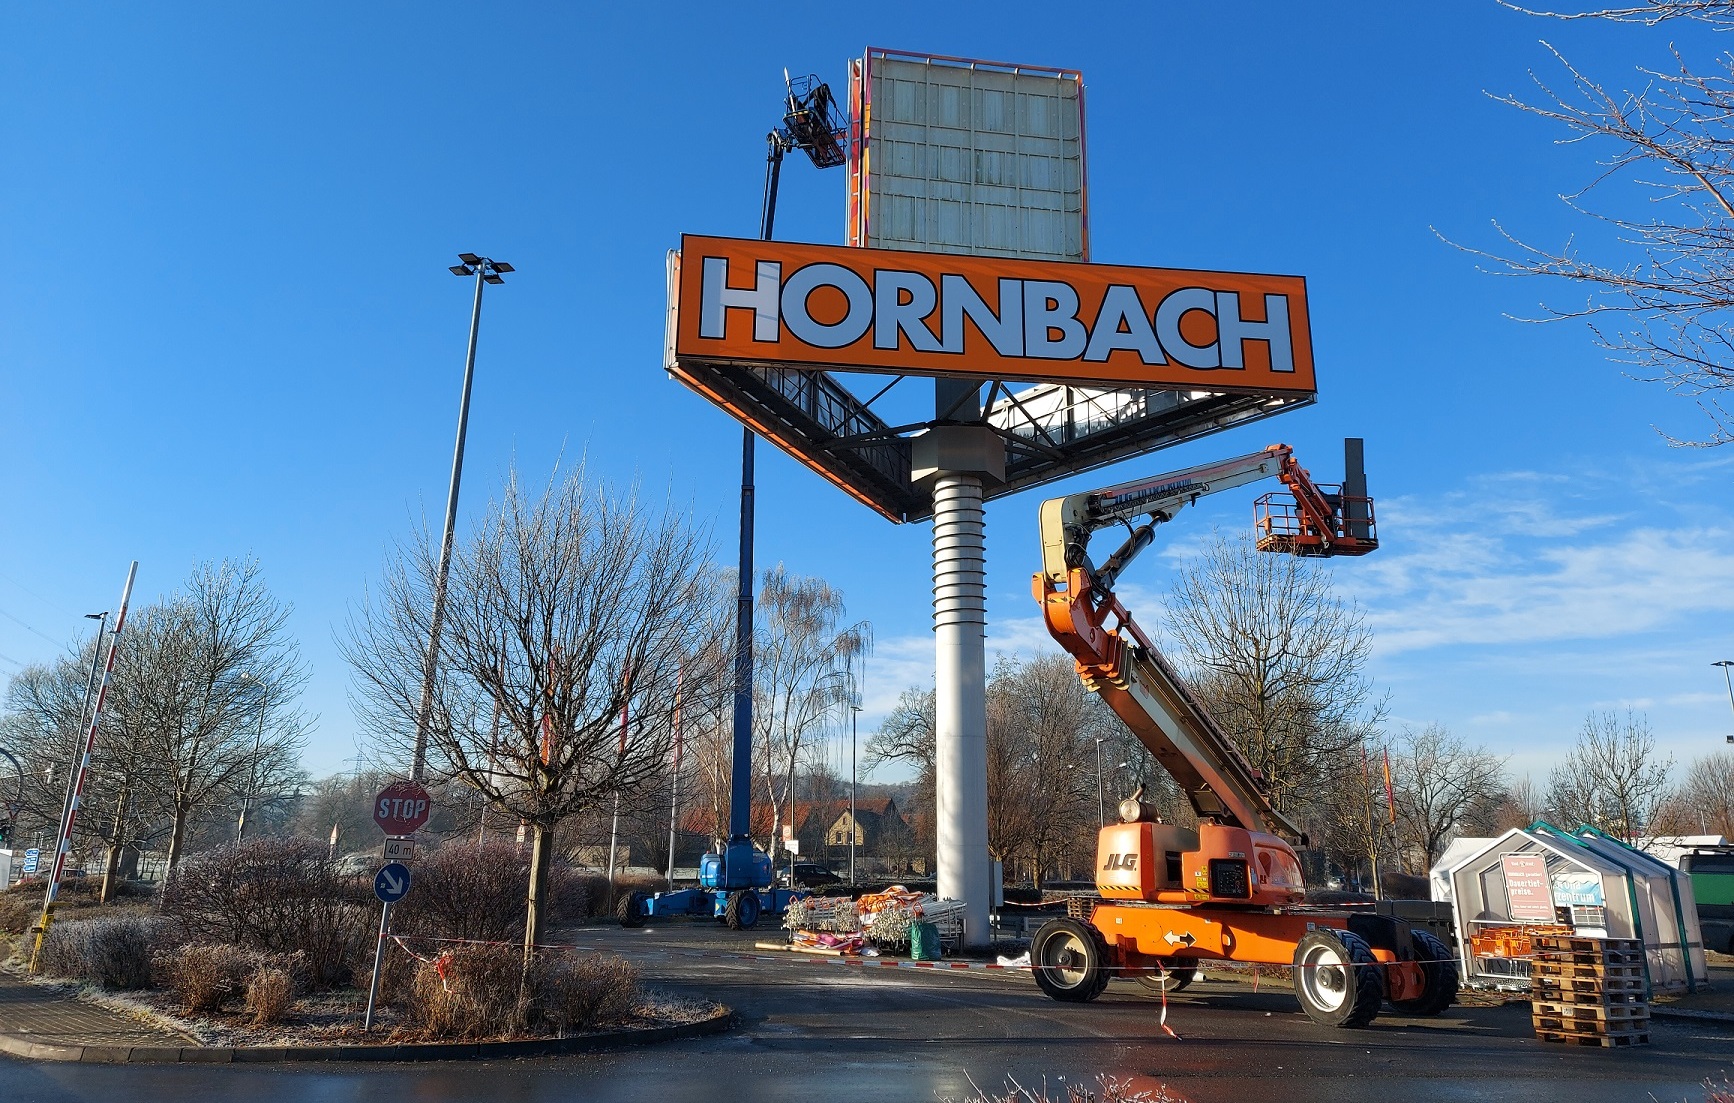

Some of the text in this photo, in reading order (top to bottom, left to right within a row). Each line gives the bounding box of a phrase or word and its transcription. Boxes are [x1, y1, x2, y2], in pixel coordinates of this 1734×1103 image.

[699, 255, 1295, 373] HORNBACH
[378, 798, 426, 819] STOP
[388, 844, 411, 856] 40 m
[1511, 888, 1534, 897] preise.
[1557, 892, 1595, 902] zentrum
